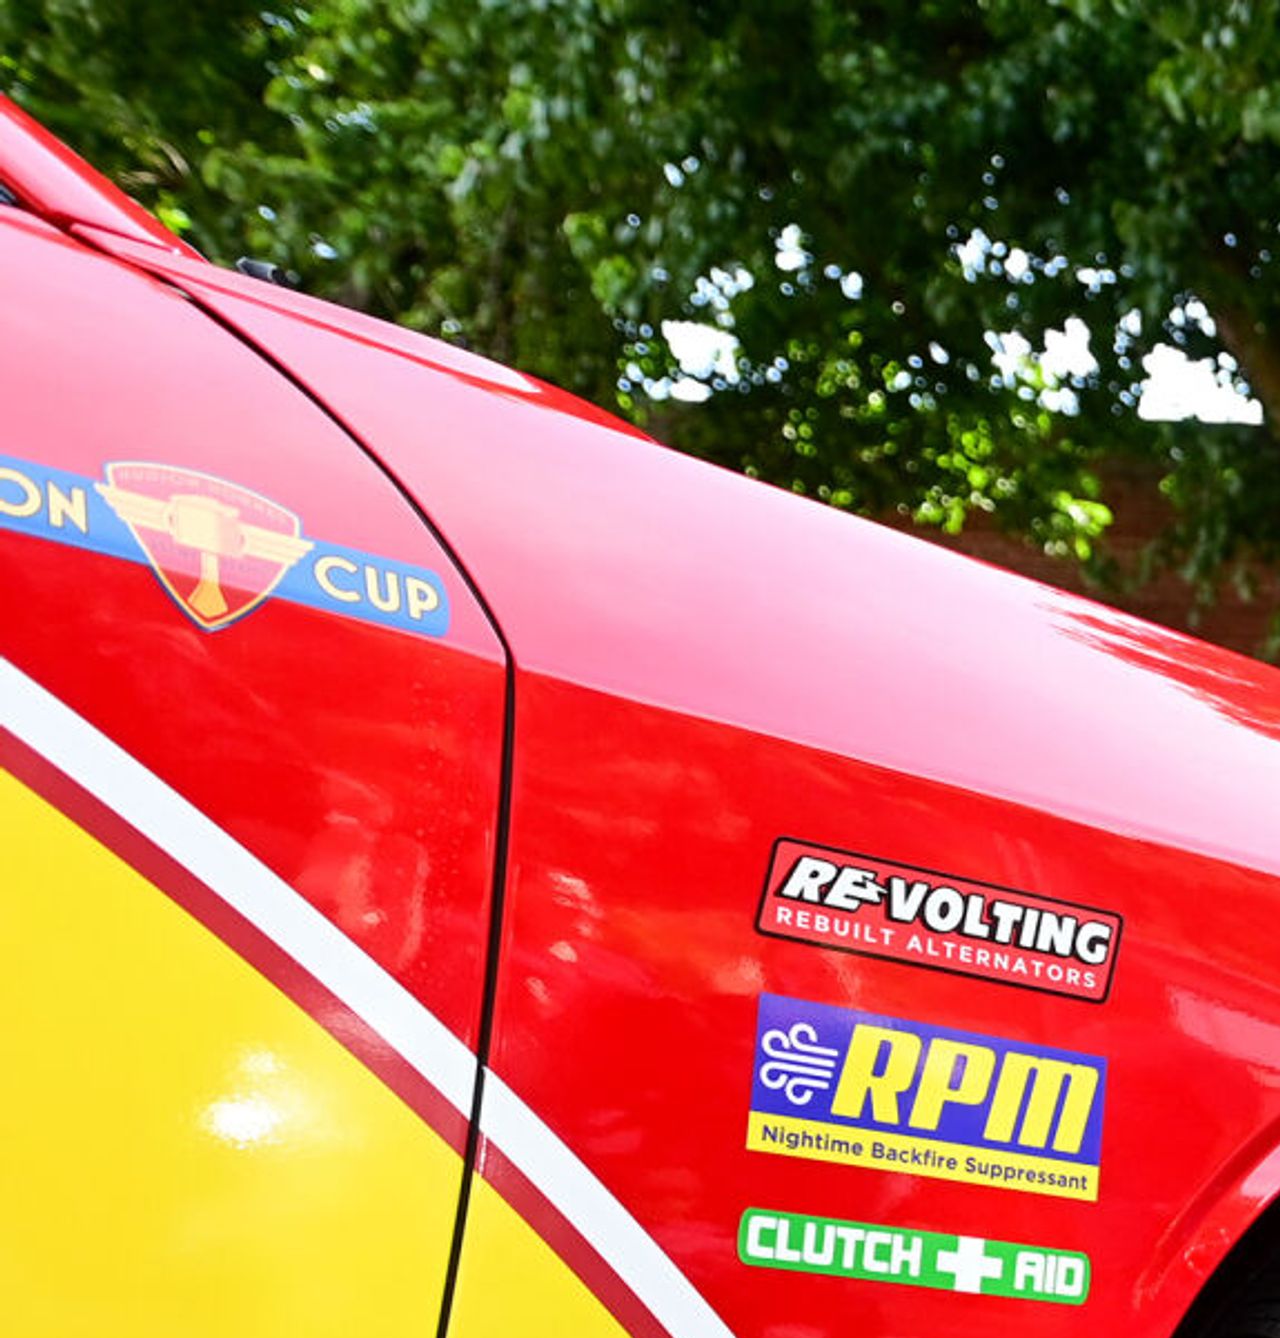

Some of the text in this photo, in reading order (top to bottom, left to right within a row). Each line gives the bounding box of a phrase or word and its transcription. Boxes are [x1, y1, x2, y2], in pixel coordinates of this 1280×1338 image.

[313, 555, 440, 620] CUP
[776, 906, 1097, 989] REBUILT ALTERNATORS
[830, 1023, 1099, 1155] RPM
[761, 1124, 1089, 1193] Nightime Backfire Suppressant
[746, 1214, 1085, 1298] CLUTCH AID
